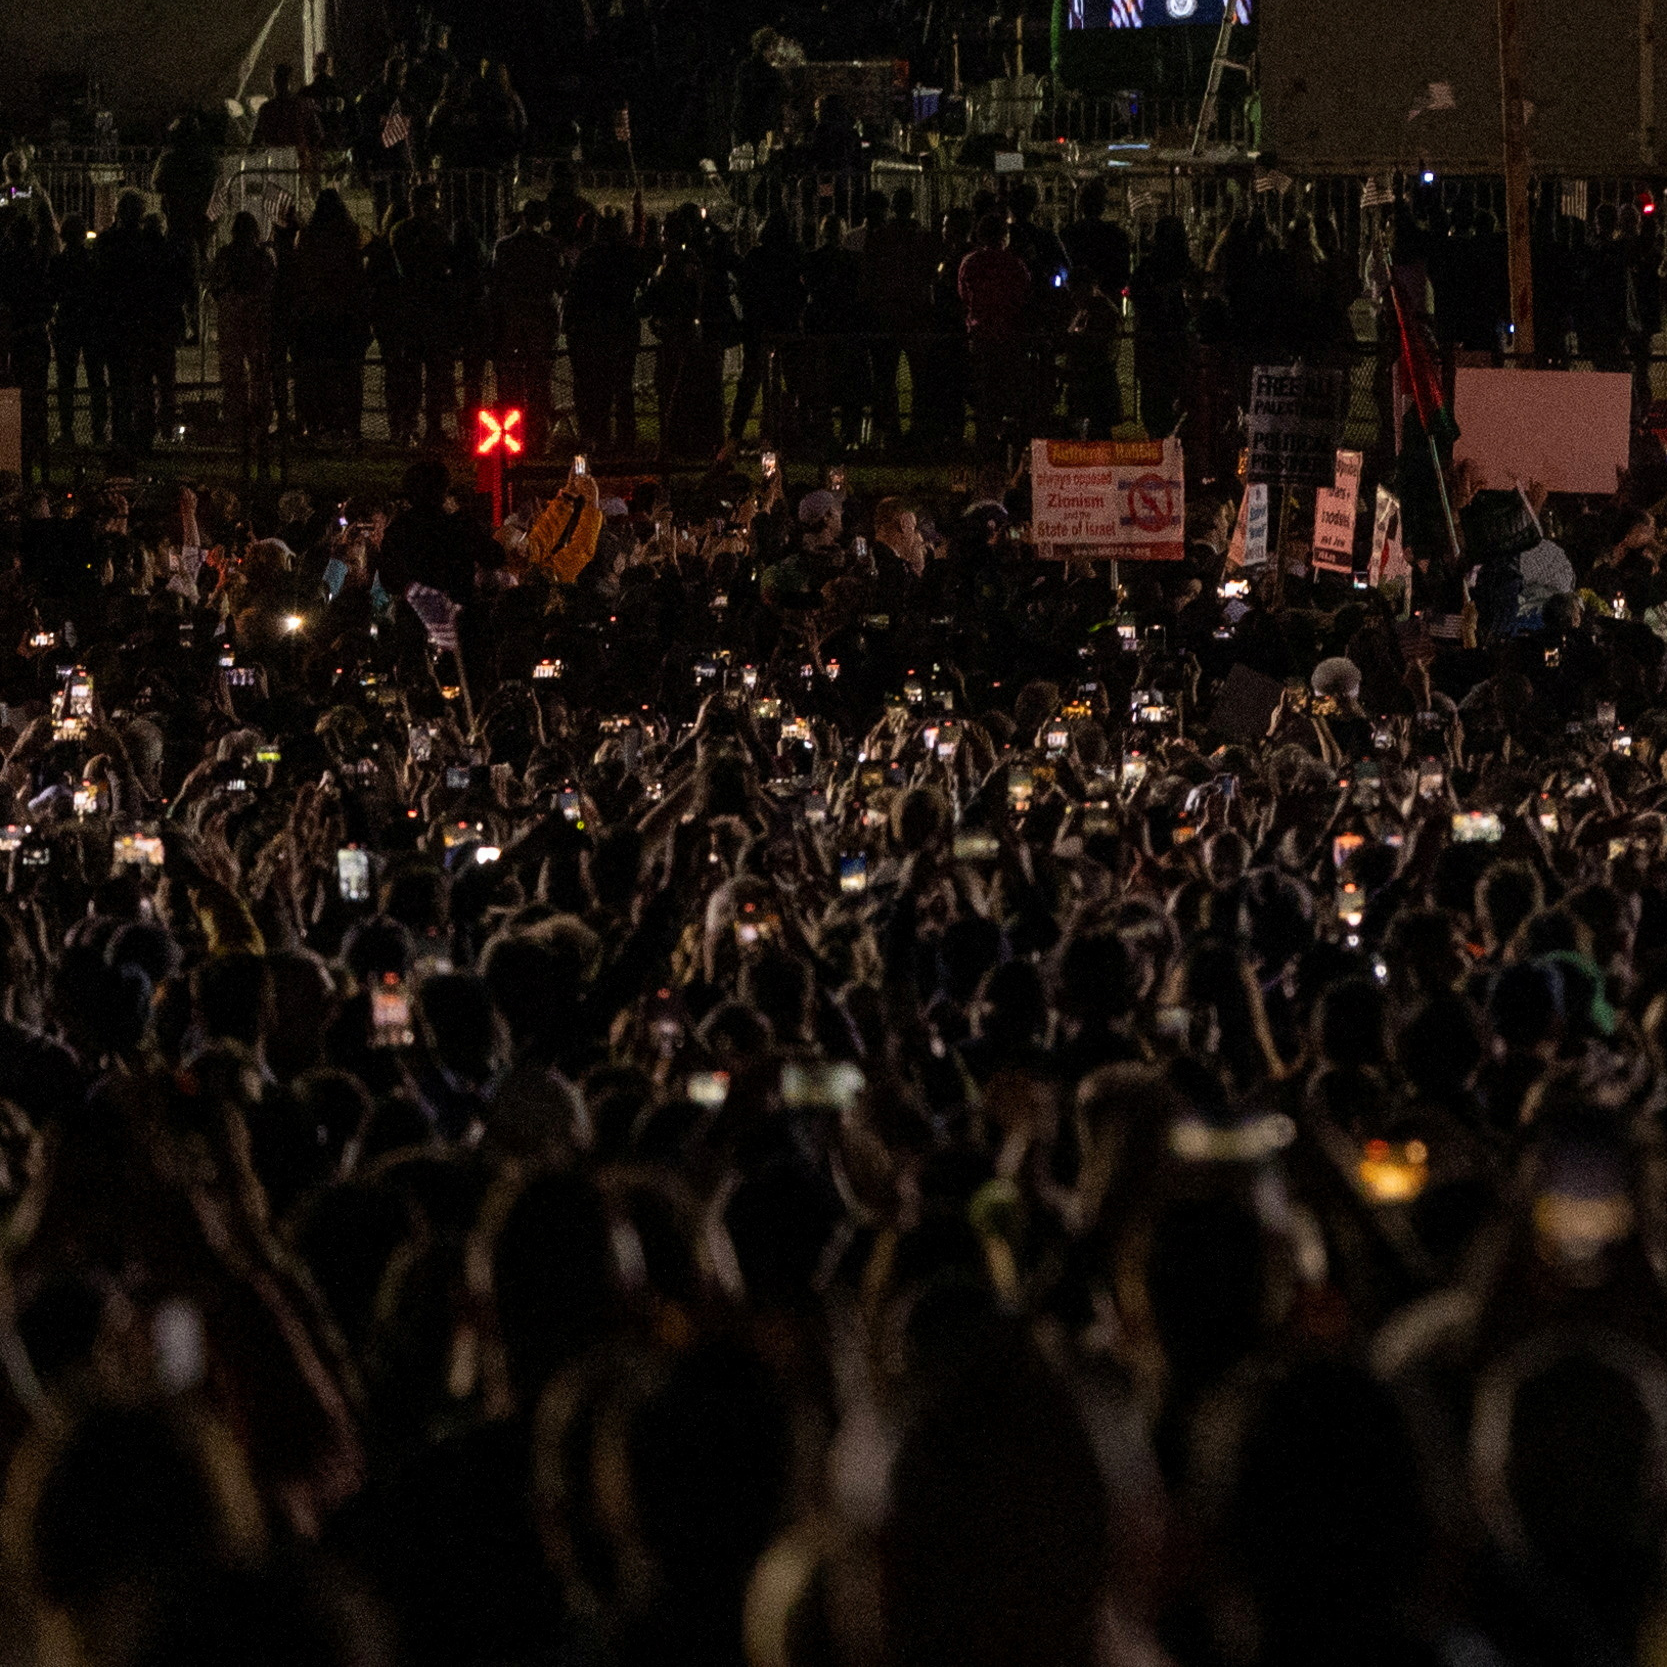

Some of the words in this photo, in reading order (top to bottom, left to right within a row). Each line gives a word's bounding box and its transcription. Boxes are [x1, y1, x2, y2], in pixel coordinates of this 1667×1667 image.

[1047, 492, 1105, 508] Zionism
[1037, 521, 1069, 537] State
[1072, 521, 1082, 535] of
[1086, 521, 1116, 536] Israel
